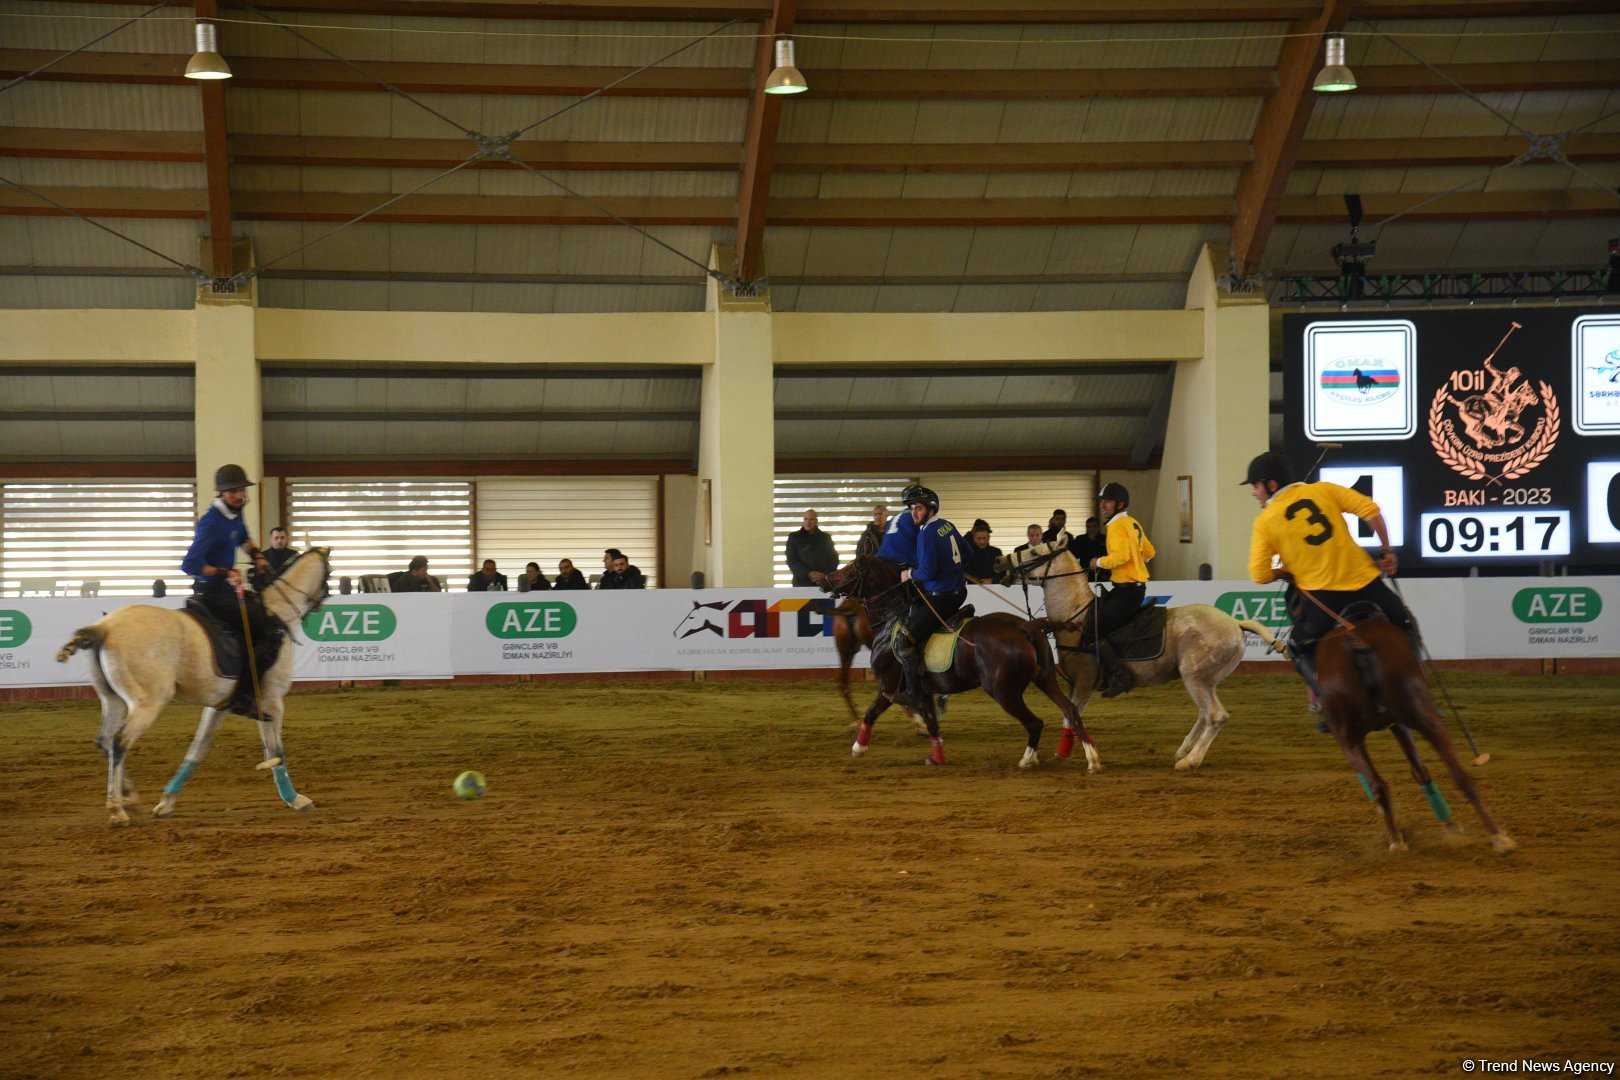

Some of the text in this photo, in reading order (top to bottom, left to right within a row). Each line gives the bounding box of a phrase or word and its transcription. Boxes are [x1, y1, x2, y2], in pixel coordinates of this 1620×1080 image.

[1443, 489, 1486, 507] BAKI
[1502, 488, 1552, 505] 2023
[1285, 498, 1334, 546] 3
[1428, 516, 1561, 553] 09:17
[949, 534, 961, 565] 4
[1231, 597, 1287, 621] AZE
[1527, 593, 1587, 617] AZE
[318, 611, 380, 635] AZE
[501, 608, 562, 632] AZE
